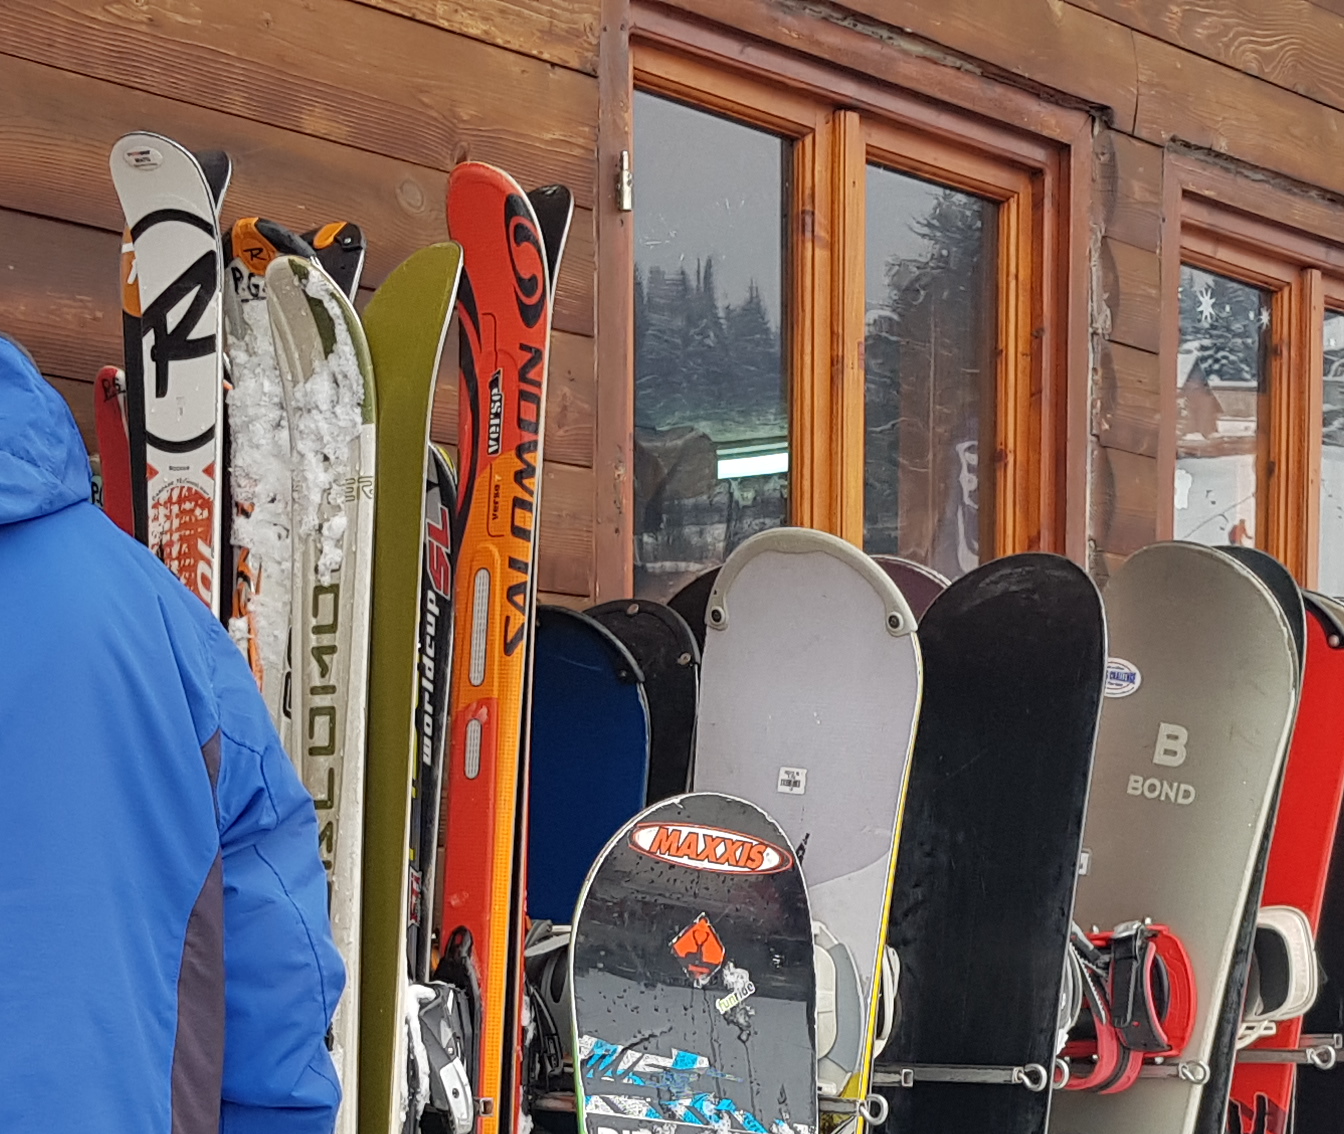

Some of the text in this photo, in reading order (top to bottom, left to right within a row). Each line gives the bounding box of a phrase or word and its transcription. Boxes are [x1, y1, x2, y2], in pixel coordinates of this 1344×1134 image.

[504, 342, 543, 656] SALOMON
[422, 504, 451, 767] worldcup SL
[649, 826, 768, 870] MAXXIS
[1127, 774, 1196, 805] BOND
